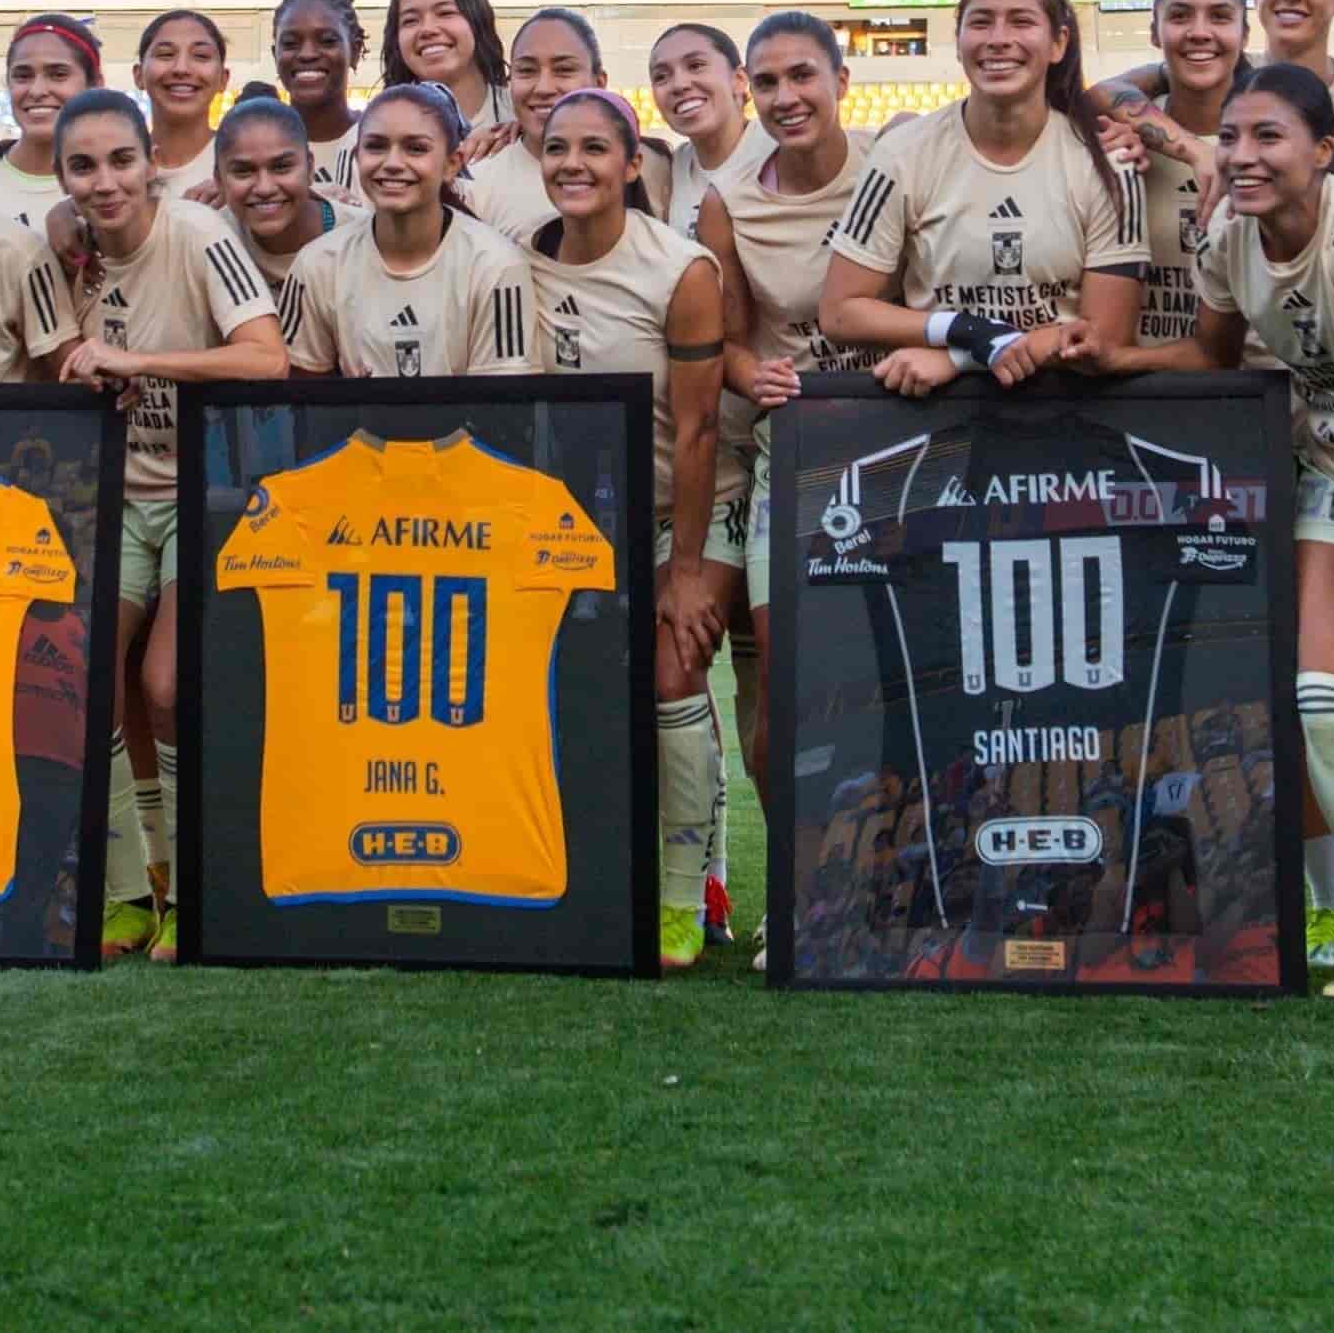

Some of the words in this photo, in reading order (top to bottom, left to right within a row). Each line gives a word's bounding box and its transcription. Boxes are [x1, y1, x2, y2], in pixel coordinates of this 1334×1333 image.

[934, 285, 954, 304] TE
[958, 285, 1037, 307] METISTE
[984, 470, 1116, 505] AFIRME
[371, 517, 491, 550] AFIRME
[834, 527, 871, 555] Berel
[809, 557, 832, 576] Tim
[834, 555, 889, 575] Hortons
[941, 536, 1124, 695] 100
[327, 572, 487, 728] 100
[973, 726, 1100, 765] SANTIAGO
[364, 760, 417, 794] JANA
[425, 763, 445, 795] G.
[362, 832, 449, 855] H-E-B
[991, 829, 1087, 852] H-E-B
